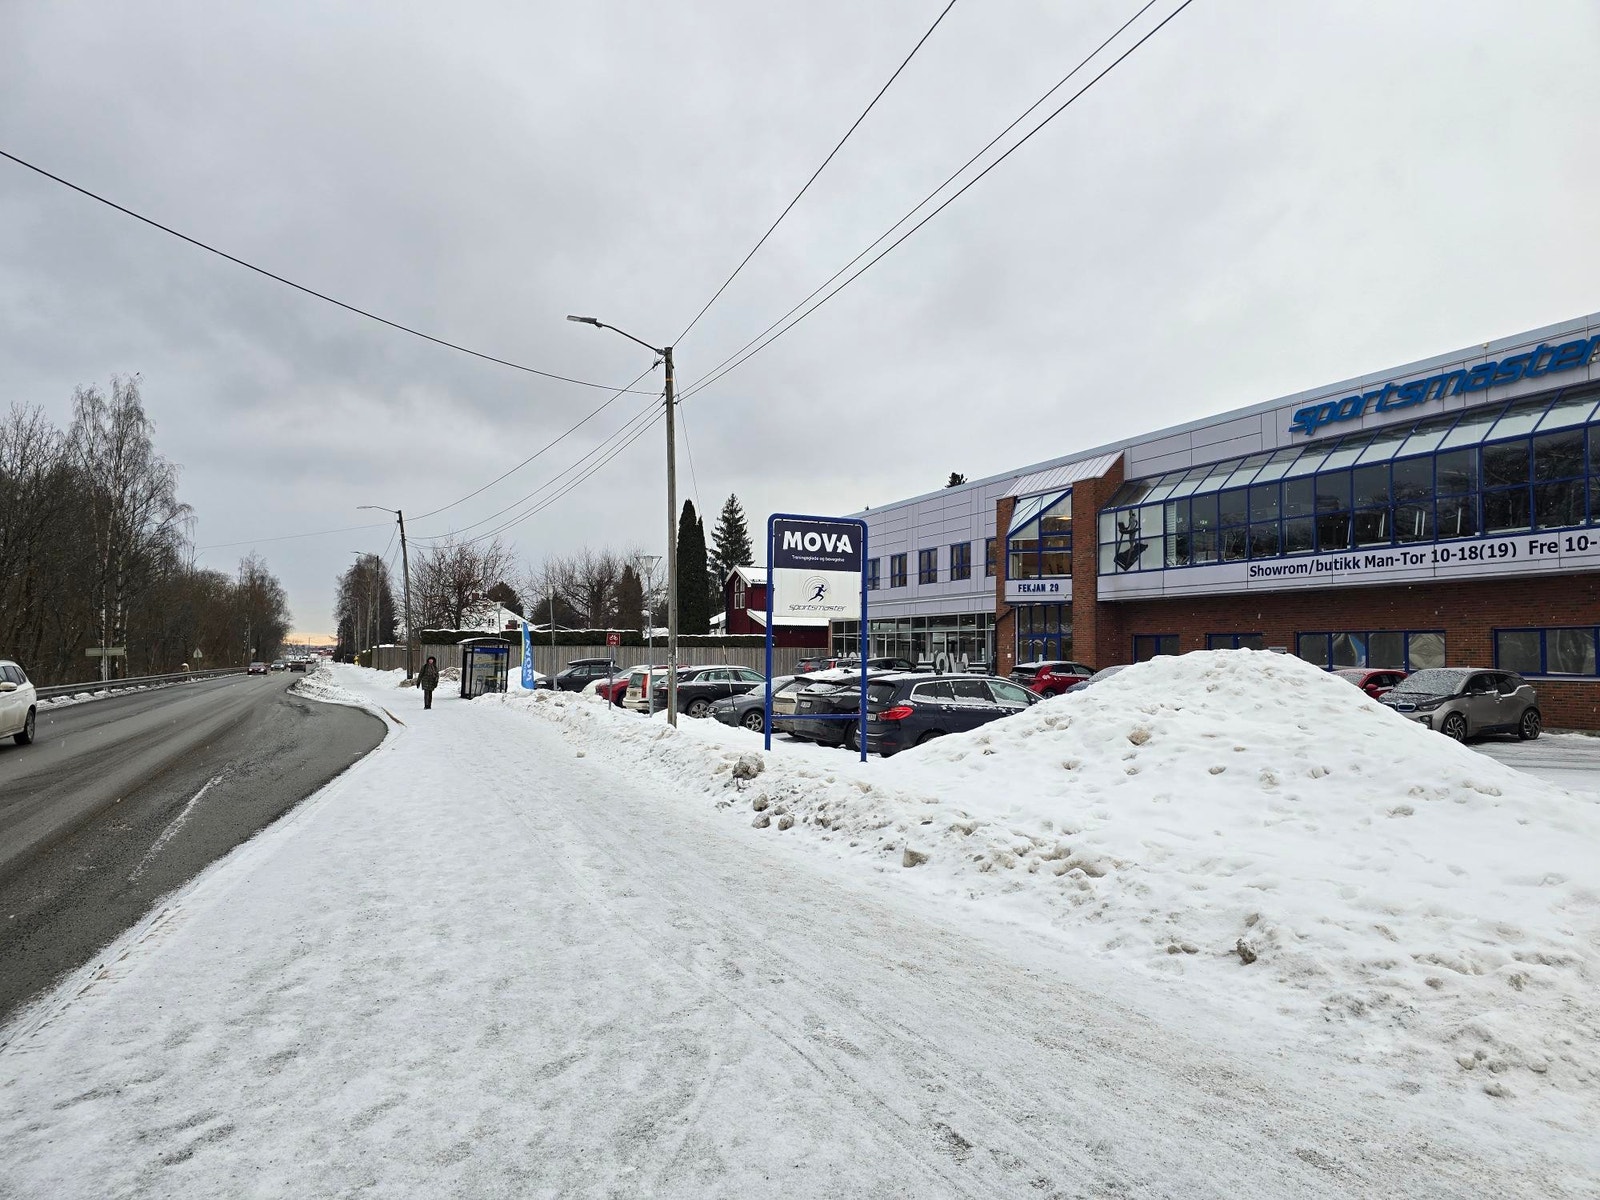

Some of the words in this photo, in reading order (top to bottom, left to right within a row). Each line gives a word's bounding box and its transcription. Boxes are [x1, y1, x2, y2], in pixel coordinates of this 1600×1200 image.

[1289, 334, 1600, 435] sportsmaster
[782, 530, 853, 554] MOVA
[1249, 556, 1361, 578] Showrom/butikk
[1364, 552, 1425, 569] Man-Tor
[1430, 541, 1517, 564] 10-18(19)
[1528, 540, 1558, 555] Fre
[1565, 535, 1600, 552] 10-
[1018, 583, 1046, 592] FEKJAN
[1049, 583, 1059, 592] 29
[788, 604, 847, 612] sportsmaster
